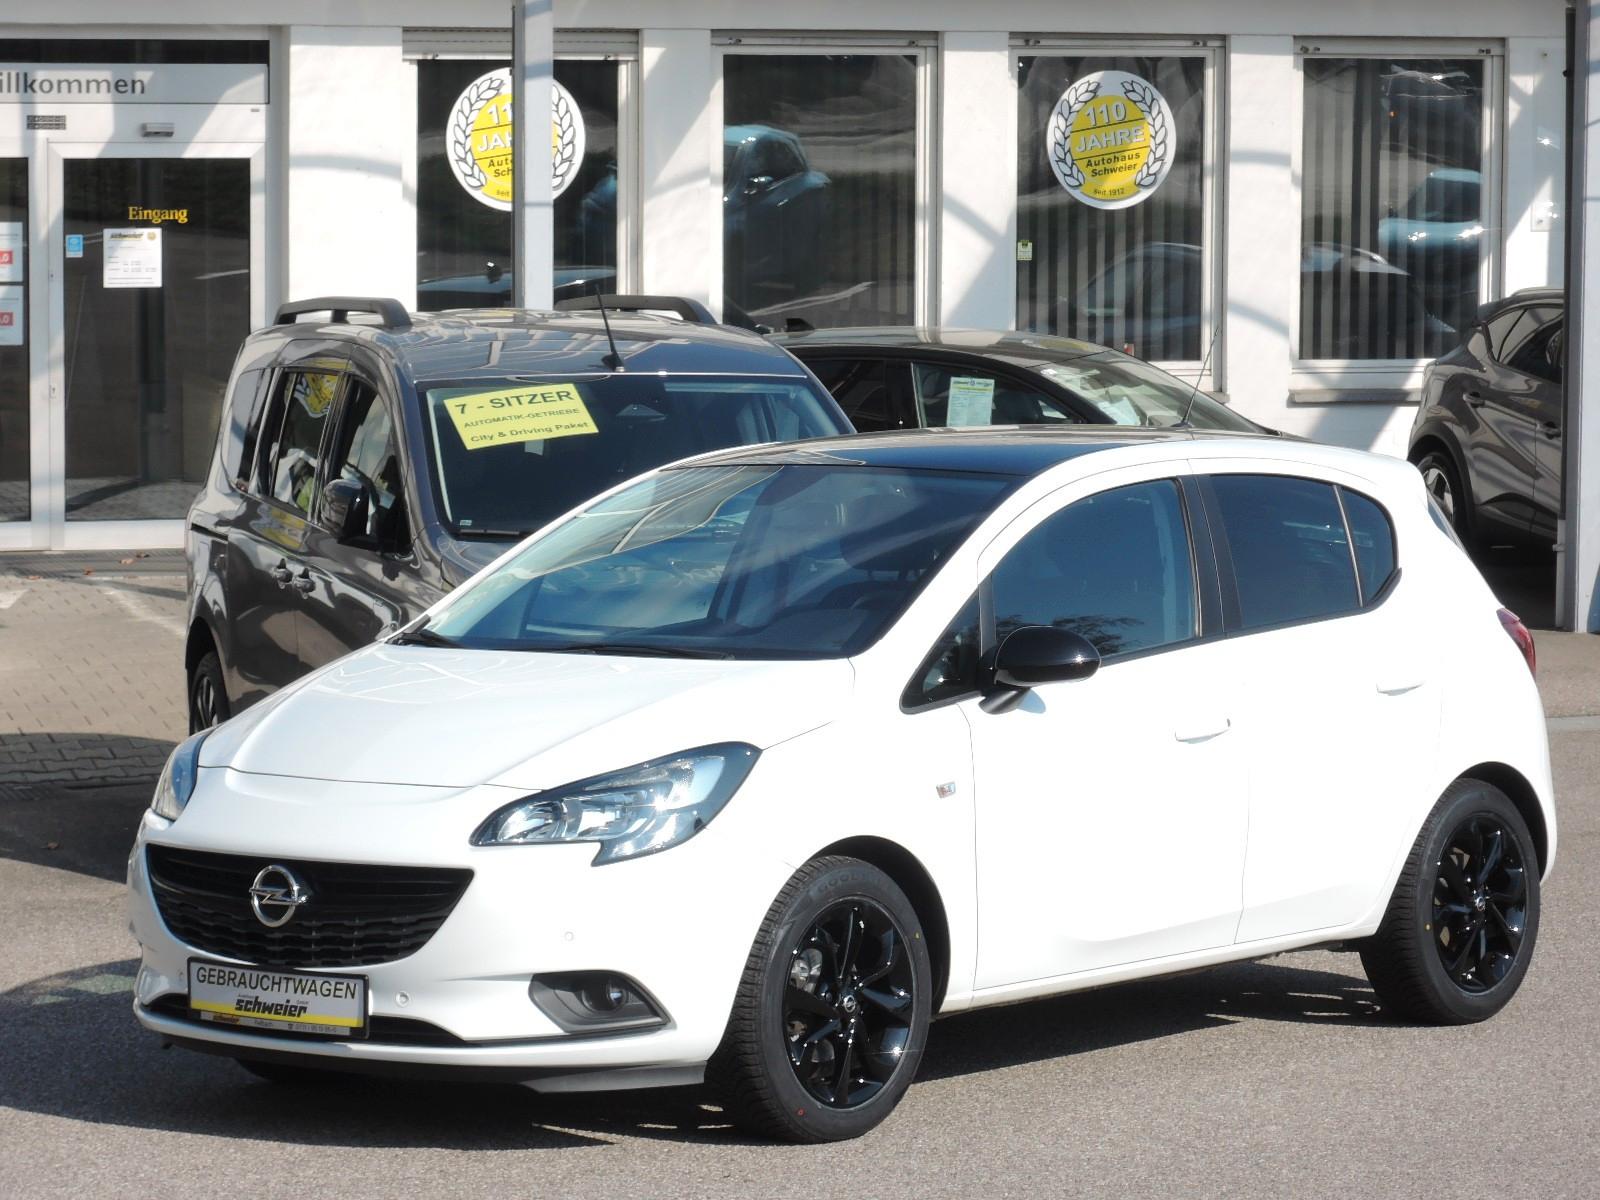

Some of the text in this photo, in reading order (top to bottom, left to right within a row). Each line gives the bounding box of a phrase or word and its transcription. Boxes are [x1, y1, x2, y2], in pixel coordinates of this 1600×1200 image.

[0, 72, 145, 94] illkommen
[487, 103, 513, 126] 11
[1086, 101, 1127, 127] 110
[1076, 125, 1146, 153] JAHRE
[1085, 152, 1141, 168] Autohaus
[1091, 162, 1138, 178] Schweier
[128, 206, 188, 224] Eingang
[455, 403, 467, 415] 7
[490, 390, 575, 409] SITZER
[464, 408, 580, 428] AUTOMATIK-GETRIEBE
[470, 432, 494, 442] City
[510, 427, 553, 437] Driving
[555, 421, 589, 431] Paket
[196, 966, 357, 999] GEBRAUCHTWAGEN
[235, 996, 308, 1018] schweier
